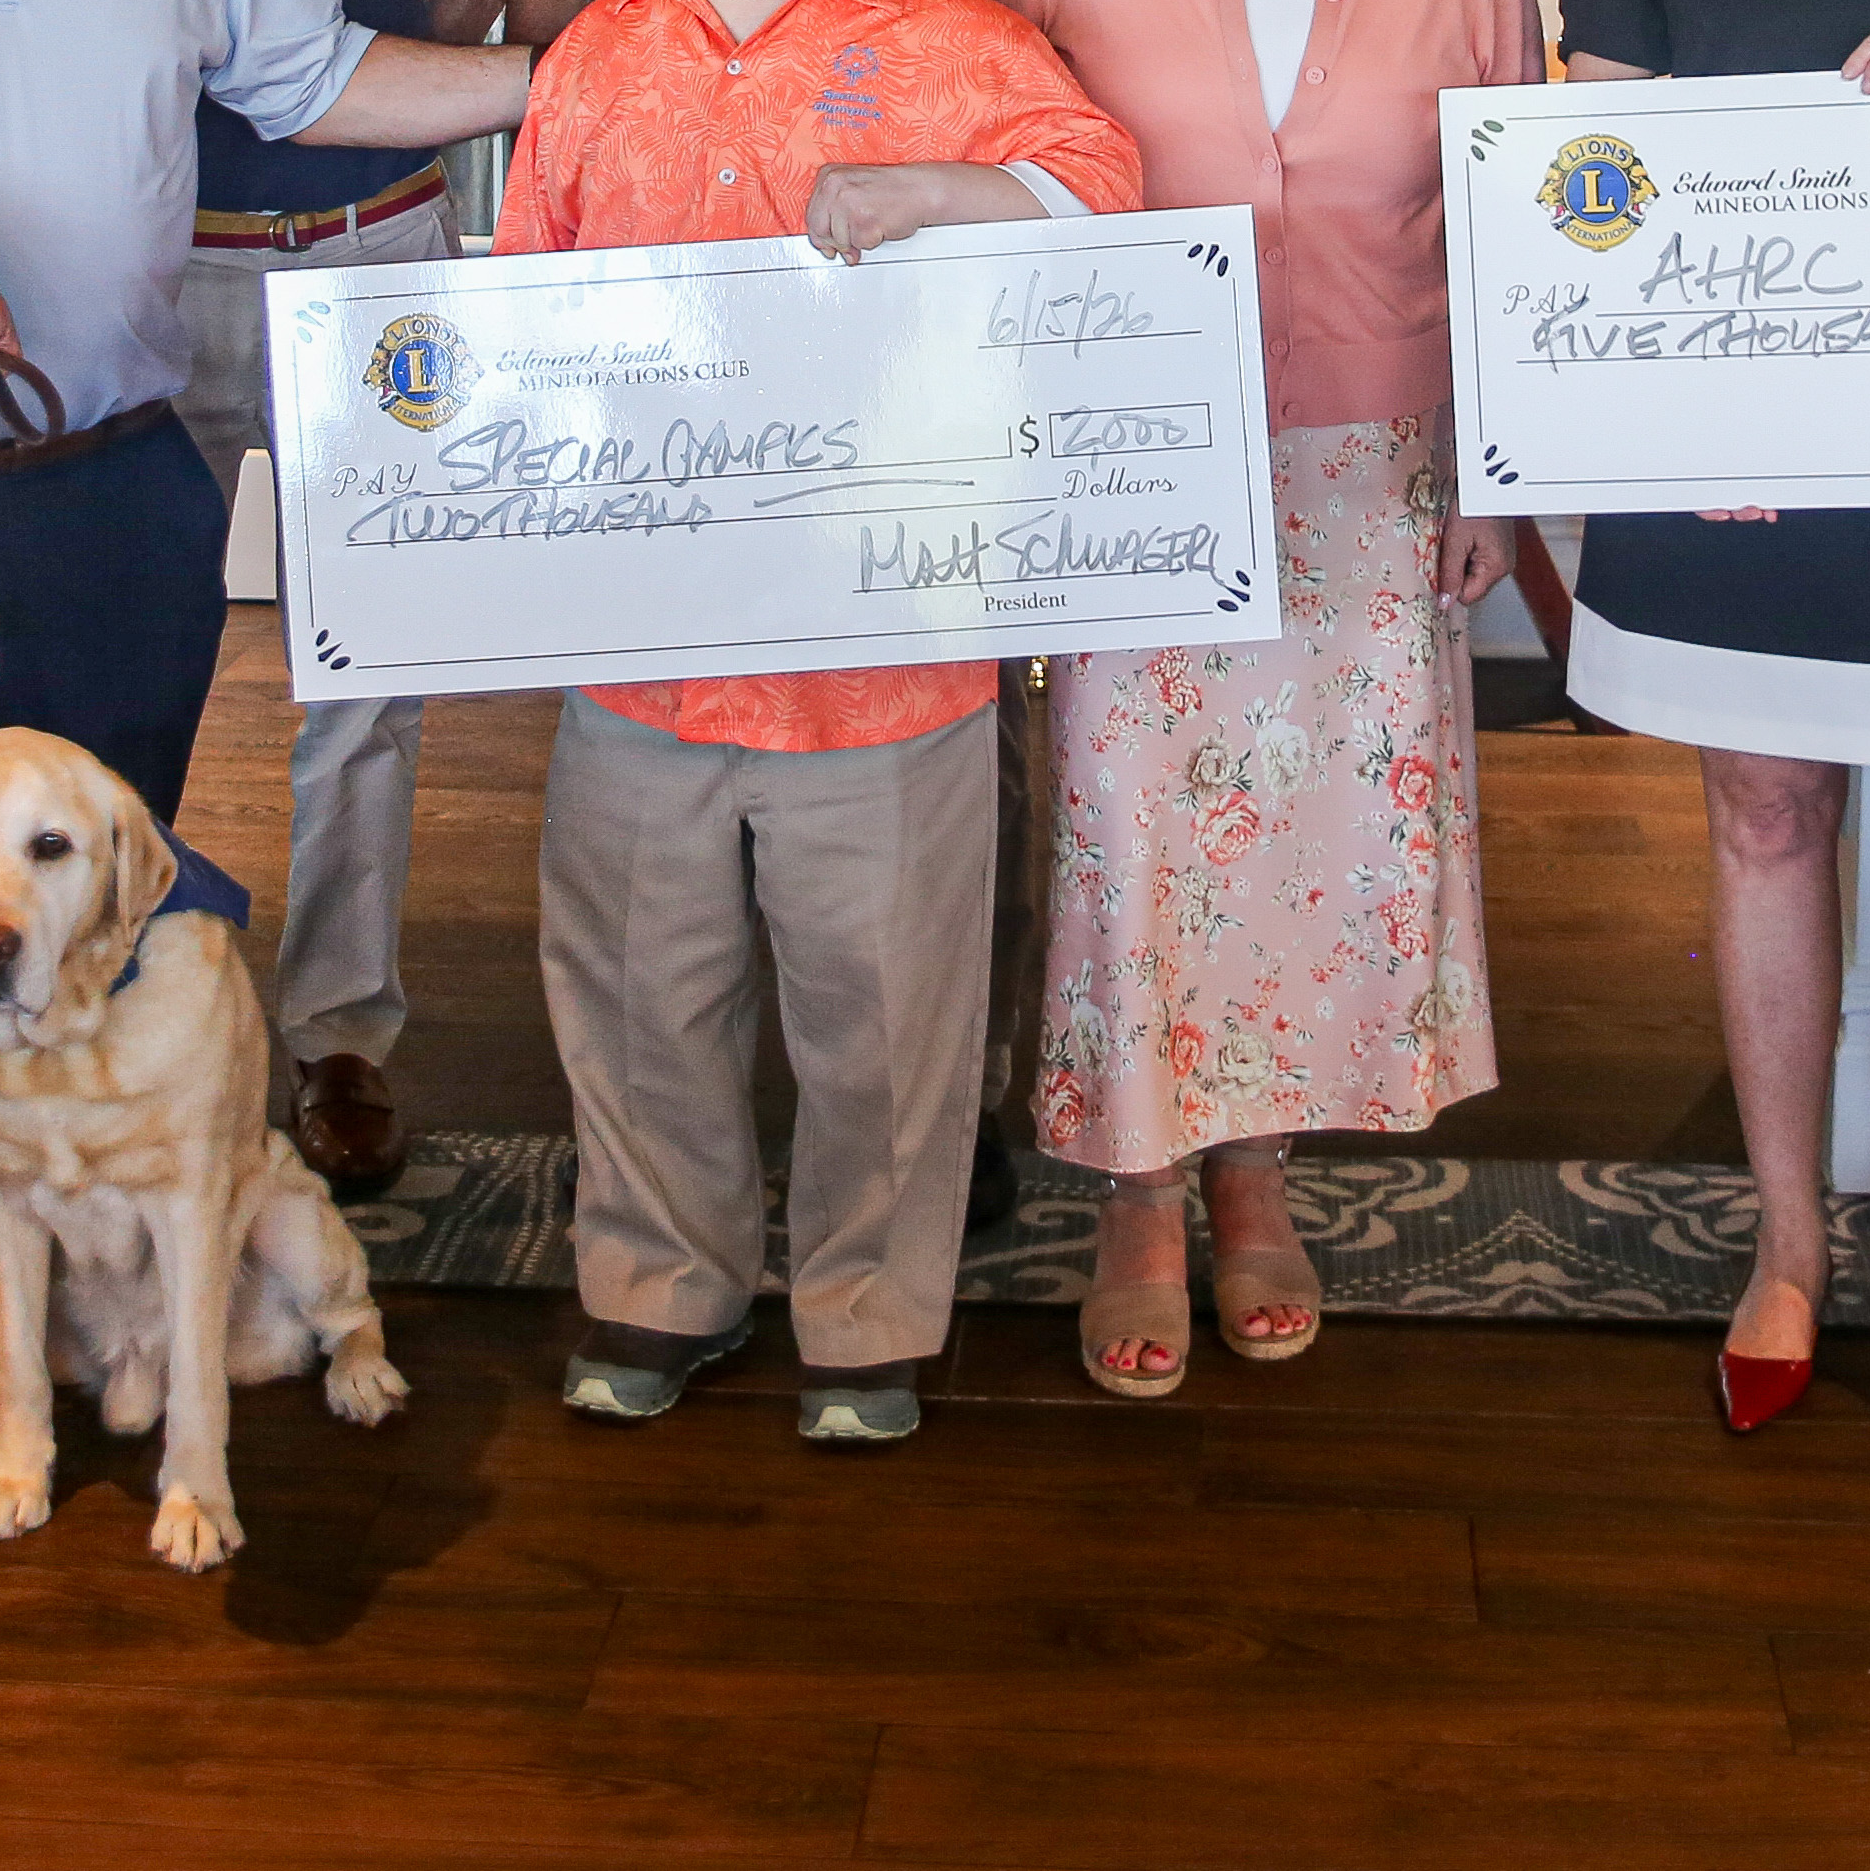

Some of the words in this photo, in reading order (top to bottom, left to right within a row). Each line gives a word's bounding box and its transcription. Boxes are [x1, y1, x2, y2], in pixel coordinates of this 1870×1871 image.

[1567, 140, 1629, 162] LIONS
[1581, 169, 1616, 213] L
[1672, 171, 1776, 195] Edward
[1779, 166, 1853, 190] Smith
[1694, 194, 1796, 215] MINEOLA
[1802, 191, 1869, 212] LIONS
[1638, 231, 1863, 306] AHRC
[987, 269, 1155, 367] 6/15/26
[1533, 298, 1667, 373] FIVE
[404, 348, 439, 392] L
[495, 348, 597, 373] Edward
[600, 338, 674, 364] Smith
[517, 369, 620, 392] MINEOLA
[626, 364, 689, 386] LIONS
[695, 359, 751, 380] CLUB
[438, 419, 651, 492] SPECIAL
[662, 418, 860, 487] OLYMPICS
[1018, 415, 1040, 458] $
[1062, 467, 1178, 499] Dollars
[346, 490, 482, 549] TWO
[482, 490, 713, 541] THOUSAND
[983, 591, 1068, 613] President
